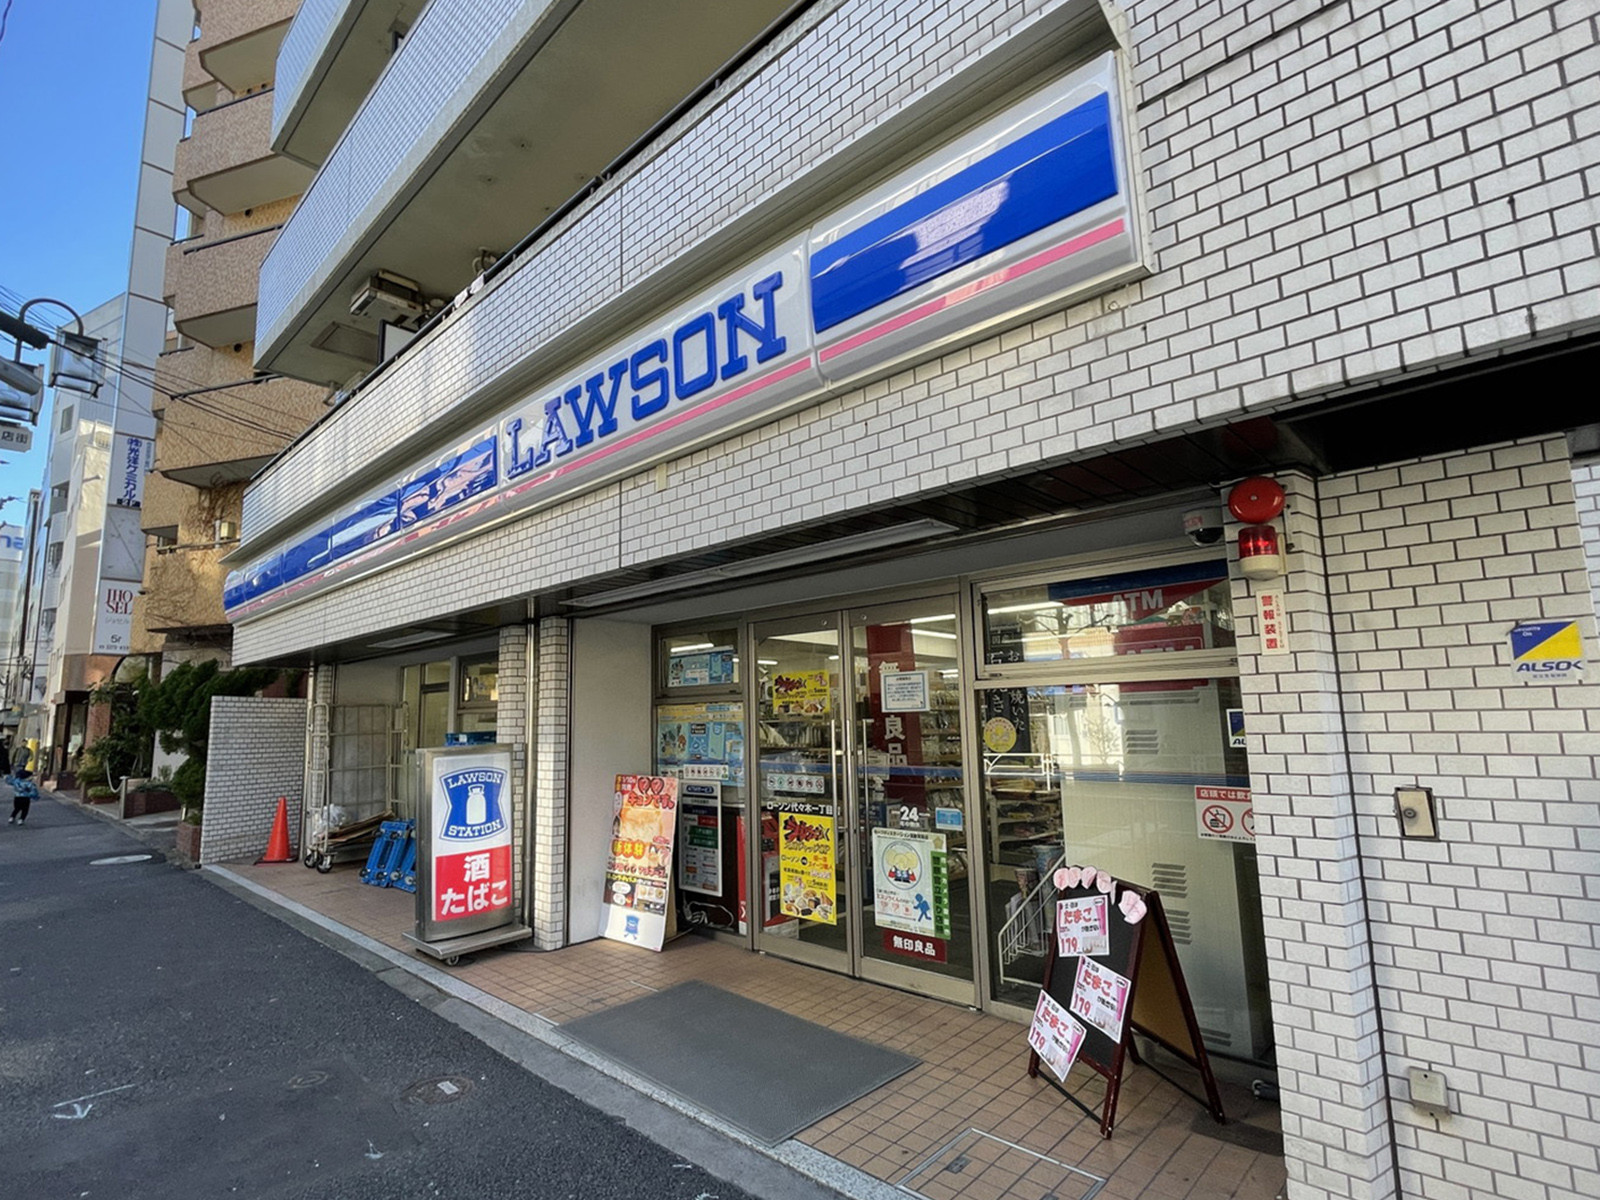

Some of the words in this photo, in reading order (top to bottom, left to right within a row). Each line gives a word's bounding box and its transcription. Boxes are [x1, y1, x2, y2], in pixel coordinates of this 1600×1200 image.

[506, 271, 787, 480] LAWSON
[1111, 588, 1164, 612] ATM
[1517, 660, 1584, 673] ALSOK
[447, 771, 502, 789] LAWSON
[766, 801, 840, 815] ローソン代々木一丁目
[900, 806, 919, 822] 24
[448, 819, 502, 837] STATION
[463, 853, 491, 882] 酒
[441, 880, 508, 916] たばこ
[893, 936, 936, 956] 無印良品
[1061, 937, 1078, 953] 179
[1073, 993, 1091, 1017] 179
[1030, 1027, 1046, 1050] 179
